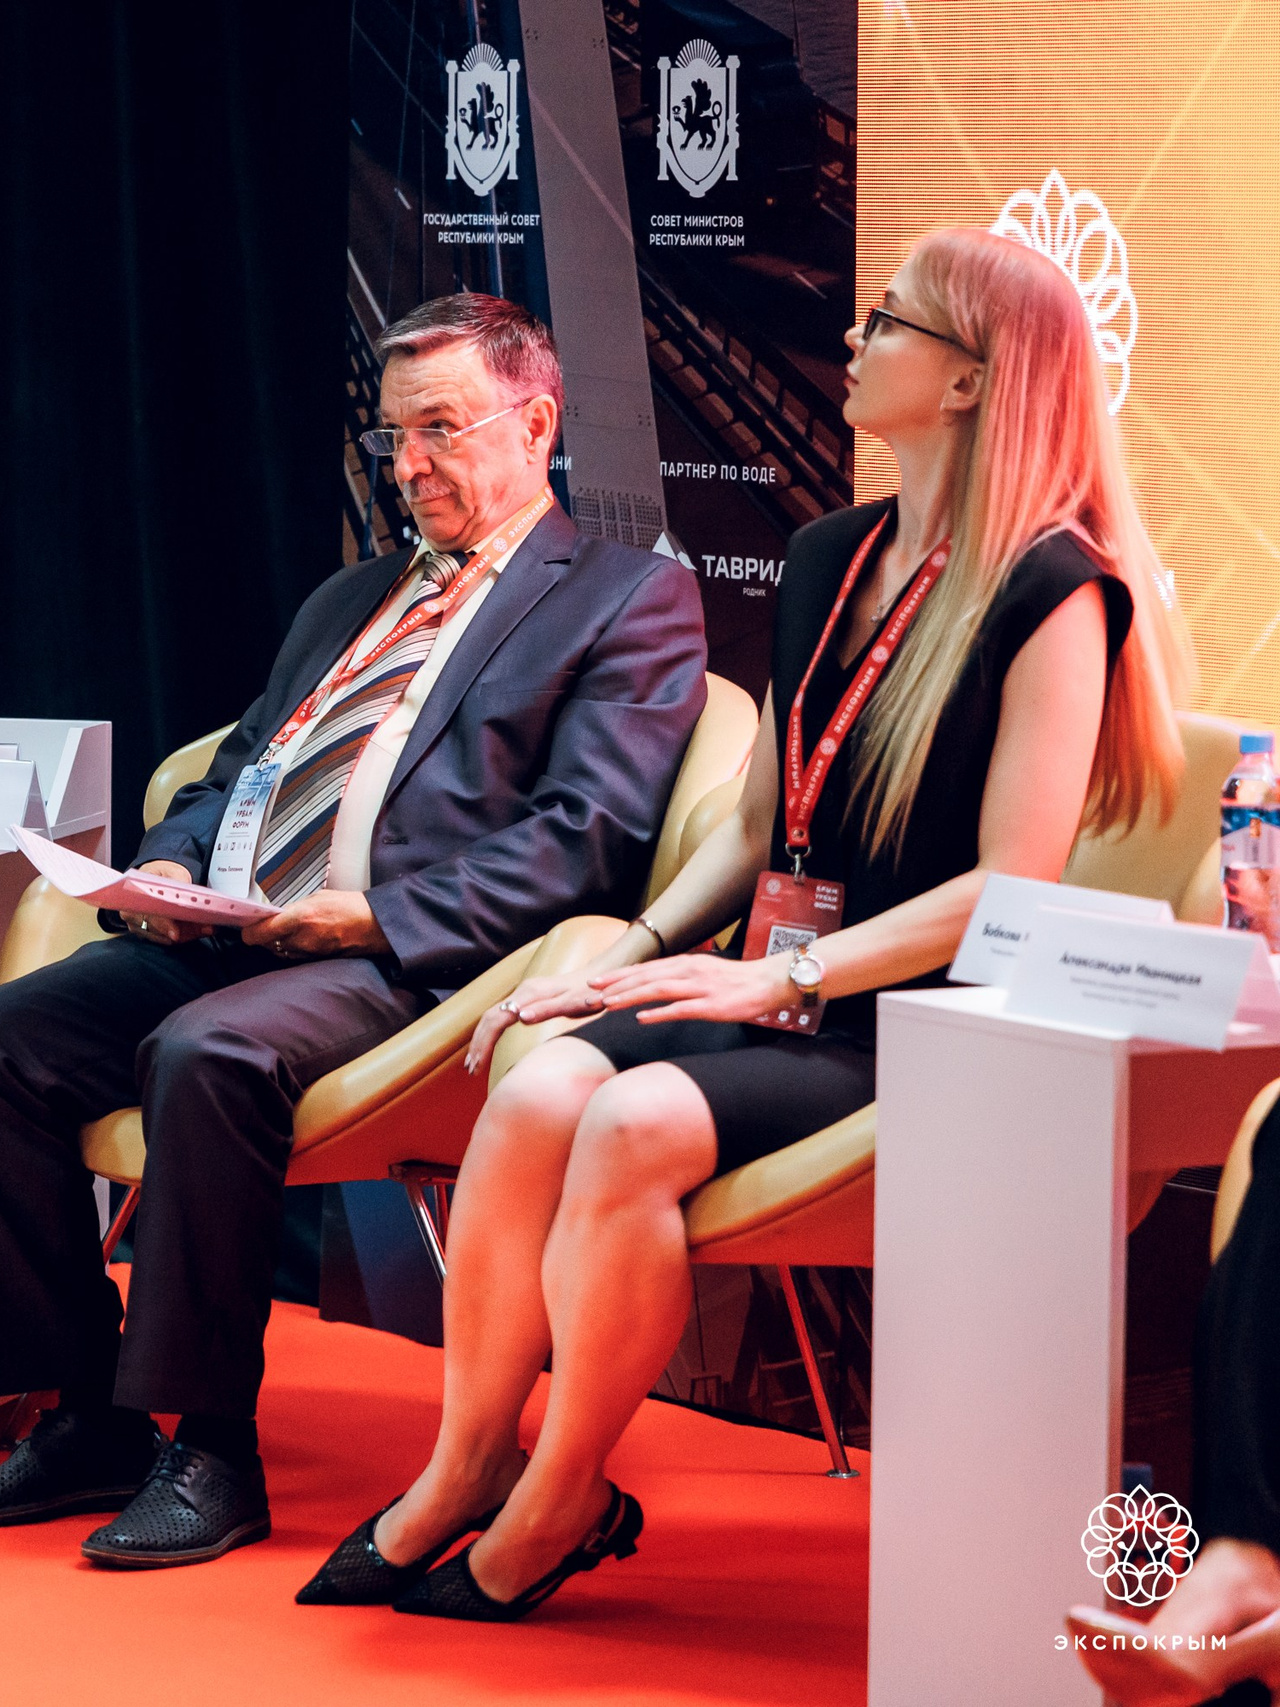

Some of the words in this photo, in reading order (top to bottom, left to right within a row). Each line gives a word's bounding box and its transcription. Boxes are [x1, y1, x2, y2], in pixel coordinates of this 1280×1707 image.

[423, 212, 508, 227] ГОСУДАРСТВЕННЫЙ
[511, 214, 540, 226] СОВЕТ
[650, 215, 681, 227] СОВЕТ
[684, 215, 744, 228] МИНИСТРОВ
[438, 231, 495, 244] РЕСПУБЛИКИ
[497, 232, 524, 245] КРЫМ
[649, 233, 712, 246] РЕСПУБЛИКИ
[715, 234, 745, 247] КРЫМ
[660, 461, 717, 479] ПАРТНЕР
[720, 464, 738, 481] ПО
[742, 466, 777, 484] ВОДЕ
[443, 554, 491, 604] ЭКСПОКРЫМ
[742, 587, 766, 597] РОДНИК
[887, 576, 931, 641] ЭКСПОКРЫМ
[371, 612, 423, 657] ЭКСПОКРЫМ
[834, 666, 875, 733] ЭКСПОКРЫМ
